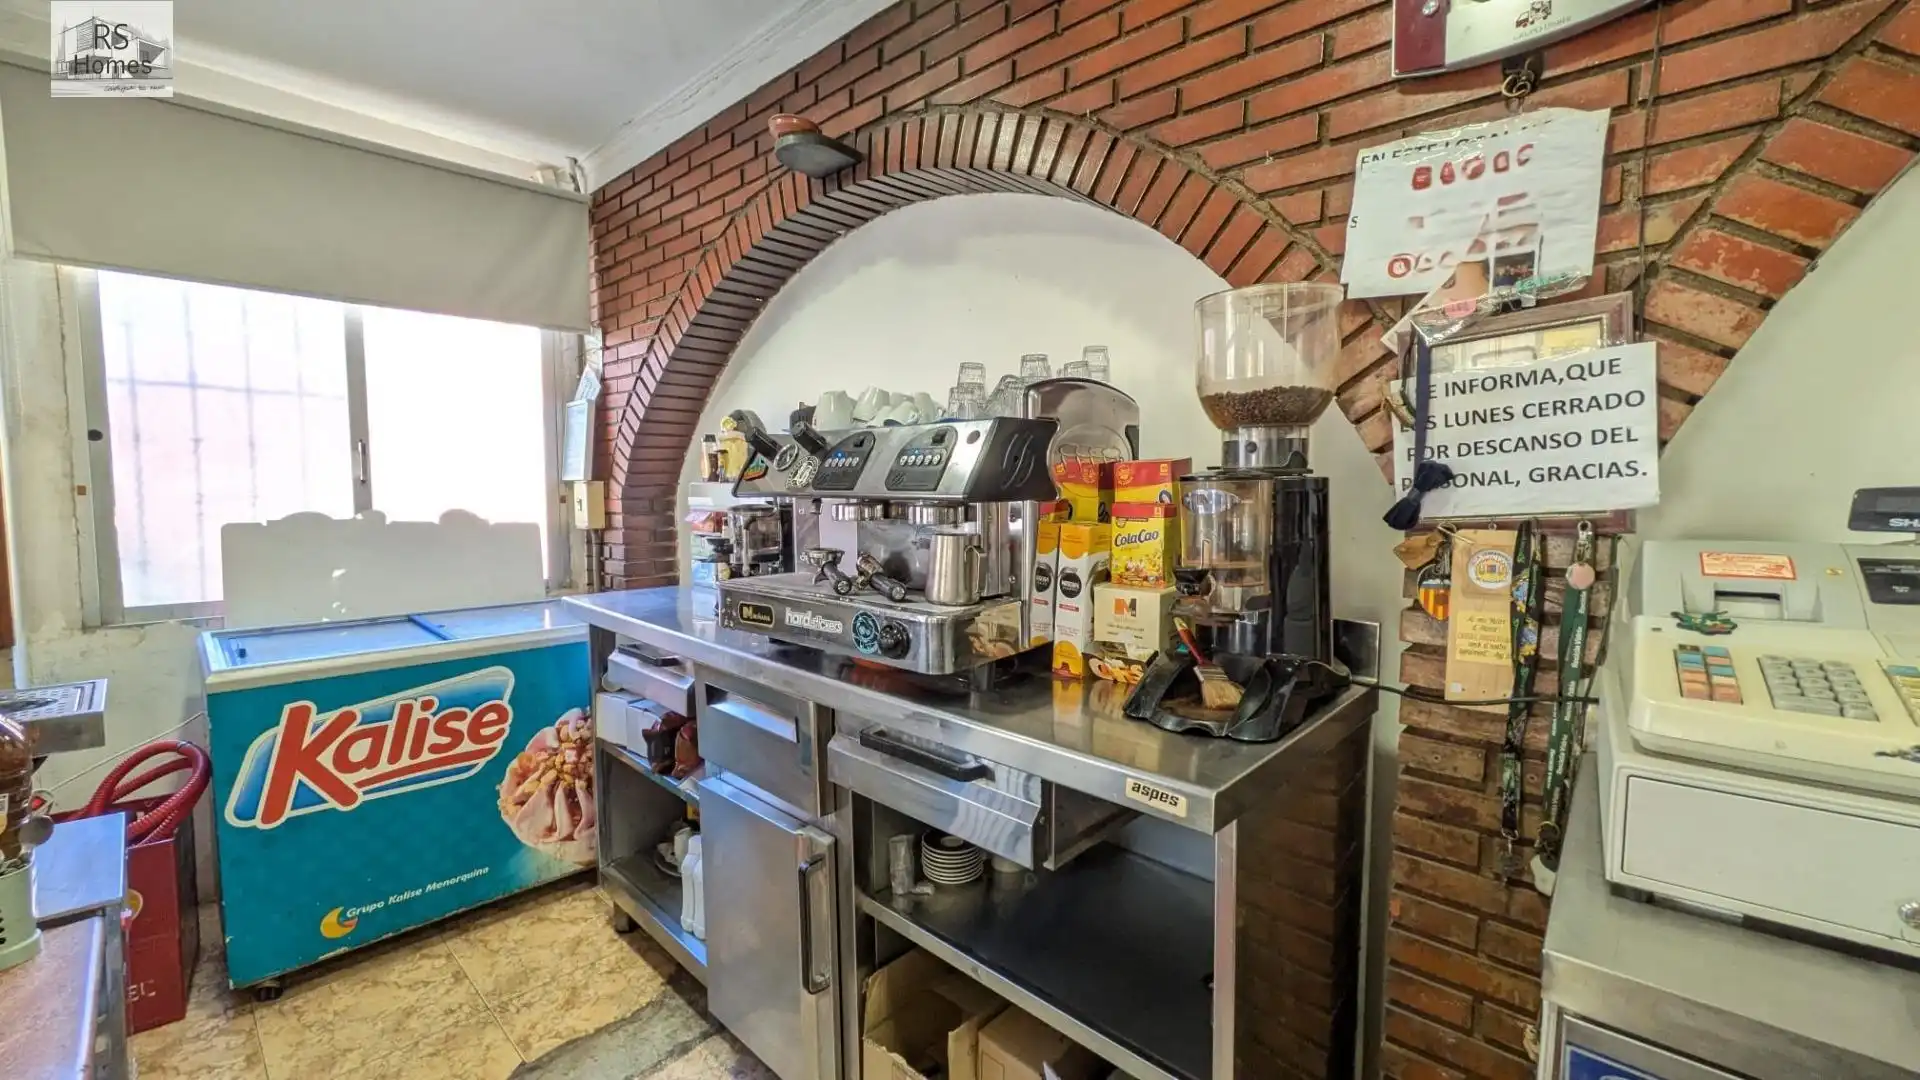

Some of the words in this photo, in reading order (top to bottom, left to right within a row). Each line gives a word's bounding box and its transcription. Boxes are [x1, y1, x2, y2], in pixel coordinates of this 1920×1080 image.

[1444, 405, 1515, 428] LUNES
[1522, 390, 1646, 420] CERRADO
[1457, 431, 1582, 458] DESCANSO
[1591, 427, 1639, 446] DEL
[1528, 460, 1648, 484] GRACIAS.
[1114, 528, 1159, 548] ColaCao
[261, 698, 510, 825] Kalise
[1131, 782, 1178, 806] aspes
[346, 901, 385, 918] Grupo
[388, 888, 423, 905] Kalise
[425, 866, 489, 893] Menorquina
